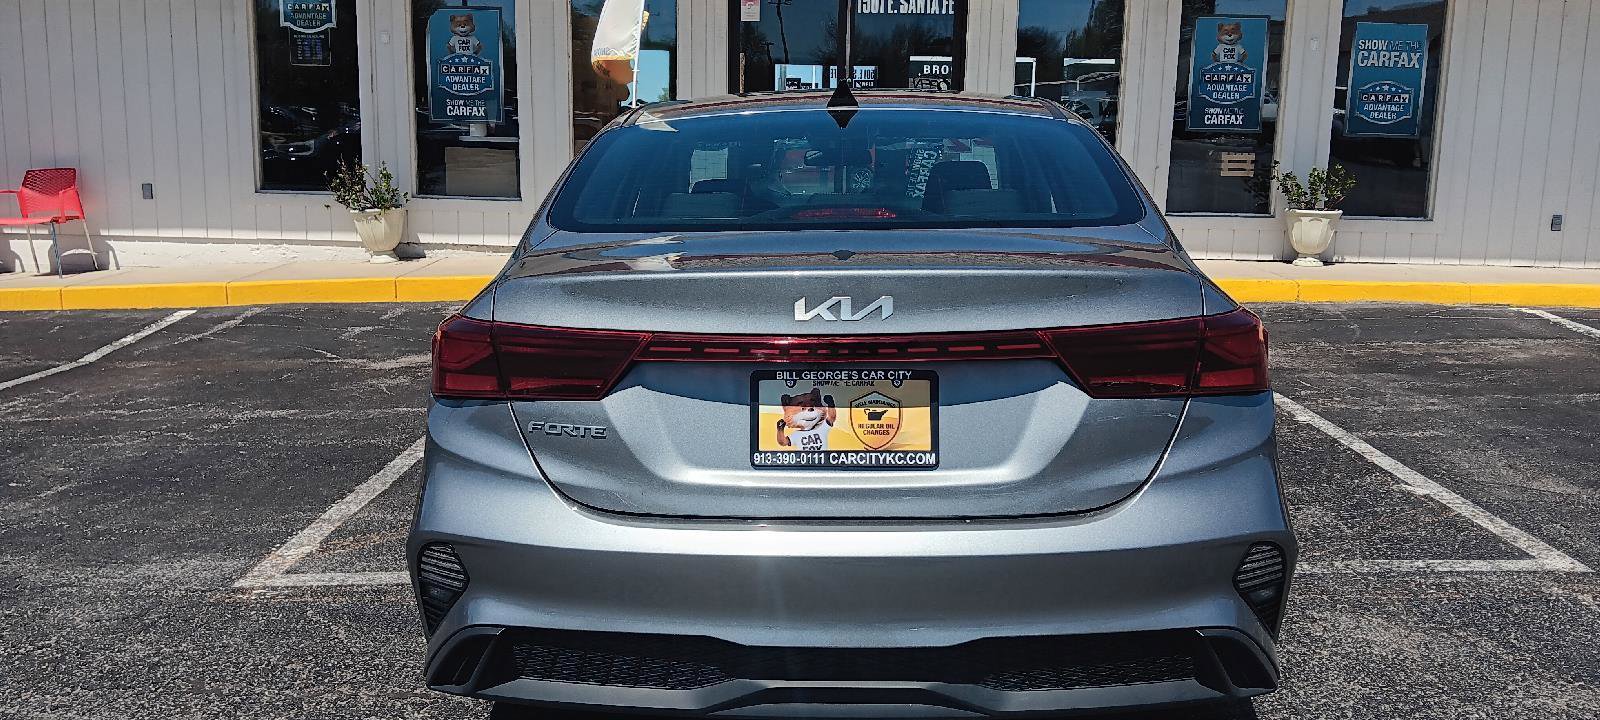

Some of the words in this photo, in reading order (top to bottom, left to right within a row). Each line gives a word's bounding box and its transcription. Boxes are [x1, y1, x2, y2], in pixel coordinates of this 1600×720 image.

[287, 3, 330, 11] CARFAX
[899, 0, 940, 14] SANTA
[942, 0, 955, 14] FE
[1358, 39, 1388, 50] SHOW
[1389, 40, 1401, 51] ME
[1406, 40, 1422, 52] THE
[1357, 51, 1422, 68] CARFAX
[442, 65, 490, 75] CARFAX
[923, 64, 952, 75] BRO
[1204, 73, 1252, 83] CARFAX
[1362, 93, 1410, 103] CARFAX
[446, 106, 486, 117] CARFAX
[1363, 104, 1405, 112] ADVANTAGE
[1204, 114, 1244, 125] CARFAX
[794, 296, 894, 321] KIA
[776, 371, 799, 380] BILL
[801, 371, 859, 380] GEORGE'S
[861, 371, 885, 380] CAR
[887, 371, 912, 380] CITY
[527, 420, 607, 440] FORTE
[800, 433, 823, 446] CAR
[753, 452, 825, 465] 913-390-0111
[829, 452, 936, 465] CARCITYKC.COM
